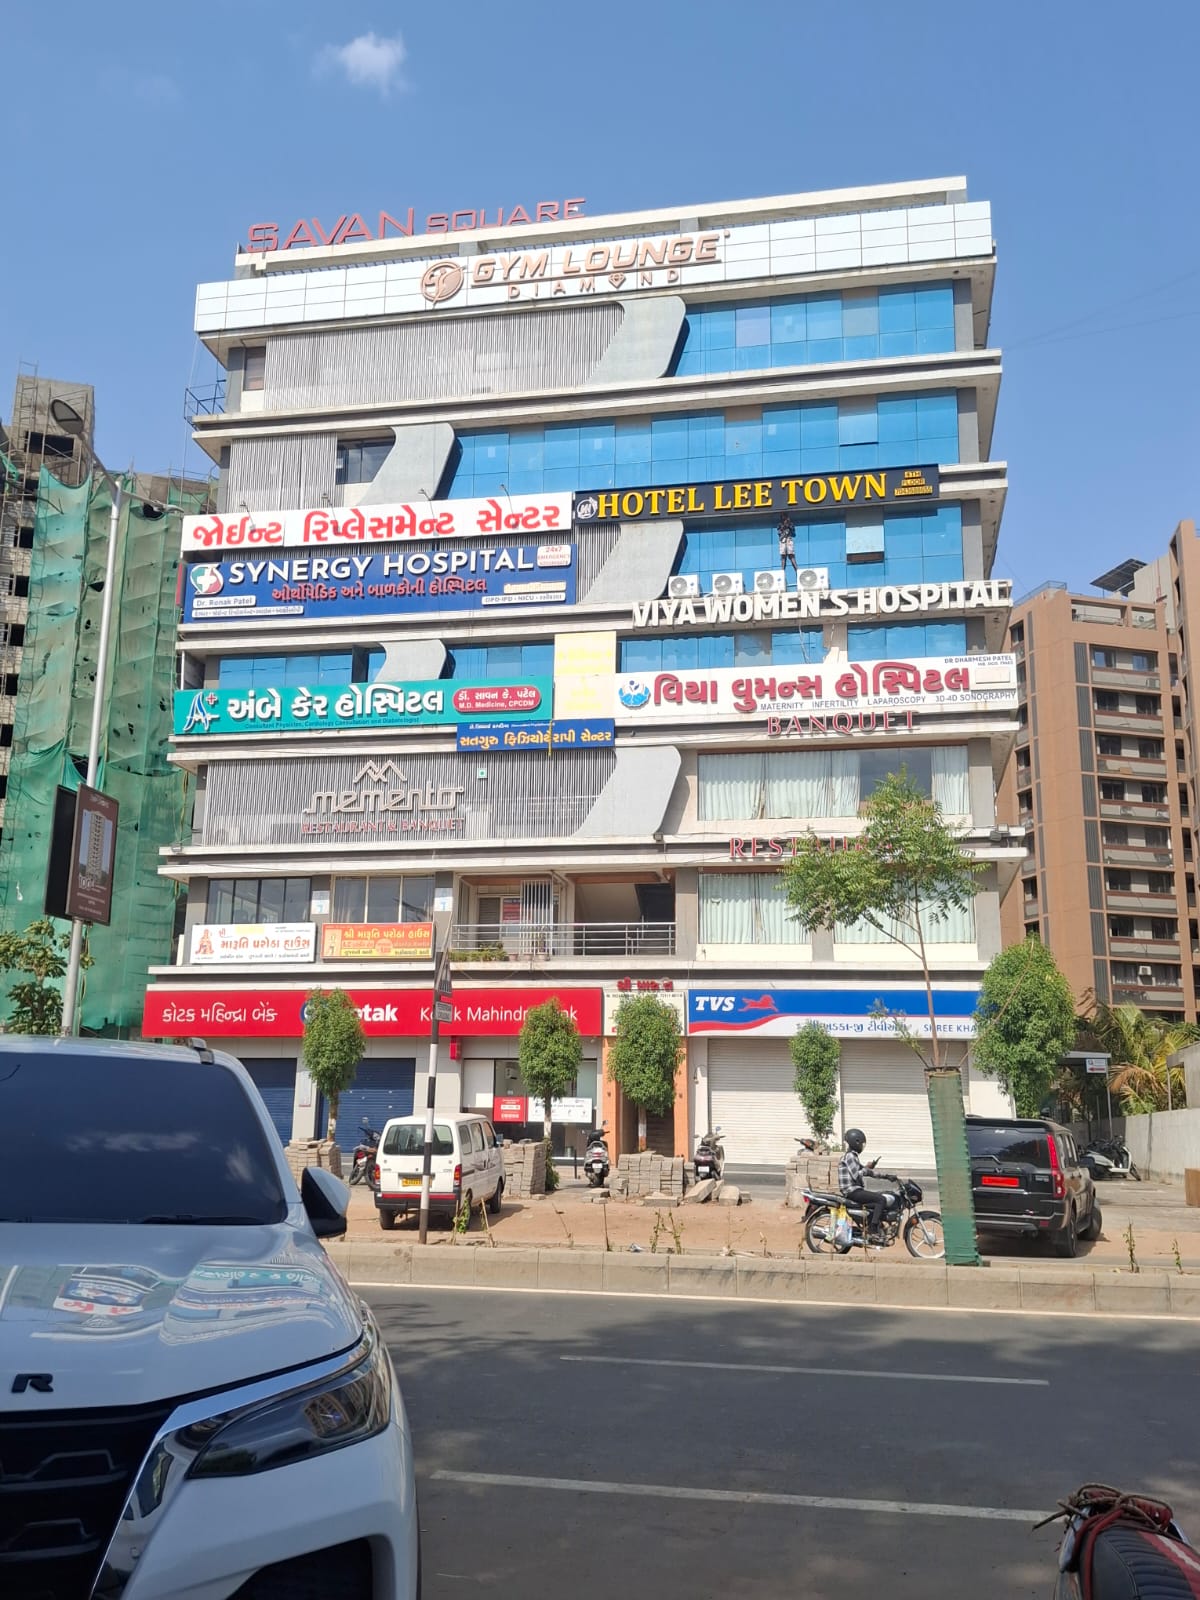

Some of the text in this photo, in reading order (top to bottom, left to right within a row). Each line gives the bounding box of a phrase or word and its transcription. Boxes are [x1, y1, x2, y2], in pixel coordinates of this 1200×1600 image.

[247, 198, 586, 253] SAVAN SQUARE
[472, 233, 720, 283] GYM LOUNGE
[901, 478, 926, 487] FLOOR
[597, 473, 887, 518] HOTEL LEE TOWN
[193, 499, 561, 546] જોઈન્ટ રિપ્લેસમેન્ટ સેન્ટર
[228, 548, 534, 584] SYNERGY HOSPITAL
[341, 581, 363, 599] અને
[367, 577, 425, 597] બાળકોની
[429, 575, 488, 595] હોસ્પિટલ
[233, 597, 253, 605] Patel
[632, 581, 1012, 628] VIYA WOMEN'S HOSPITAL
[993, 654, 1013, 662] PATEL
[517, 688, 536, 699] પટેલ
[654, 673, 718, 706] વિયા
[731, 674, 823, 713] વુમન્સ
[834, 662, 970, 699] હોસ્પિટલ
[227, 683, 444, 719] અંબે કેર હોસ્પિટલ
[760, 702, 804, 711] MATERNITY
[812, 699, 859, 709] INFERTILITY
[867, 696, 926, 706] LAPAROSCOPY
[960, 691, 1016, 702] SONOGRAPHY
[767, 710, 920, 736] BANQUET
[460, 735, 499, 750] સતગુરુ
[580, 728, 612, 742] સેન્ટર
[301, 818, 465, 835] RESTAURANT & BANQUET
[162, 1001, 279, 1022] કોટક મહિન્દ્રા બેંક
[695, 996, 736, 1012] TVS
